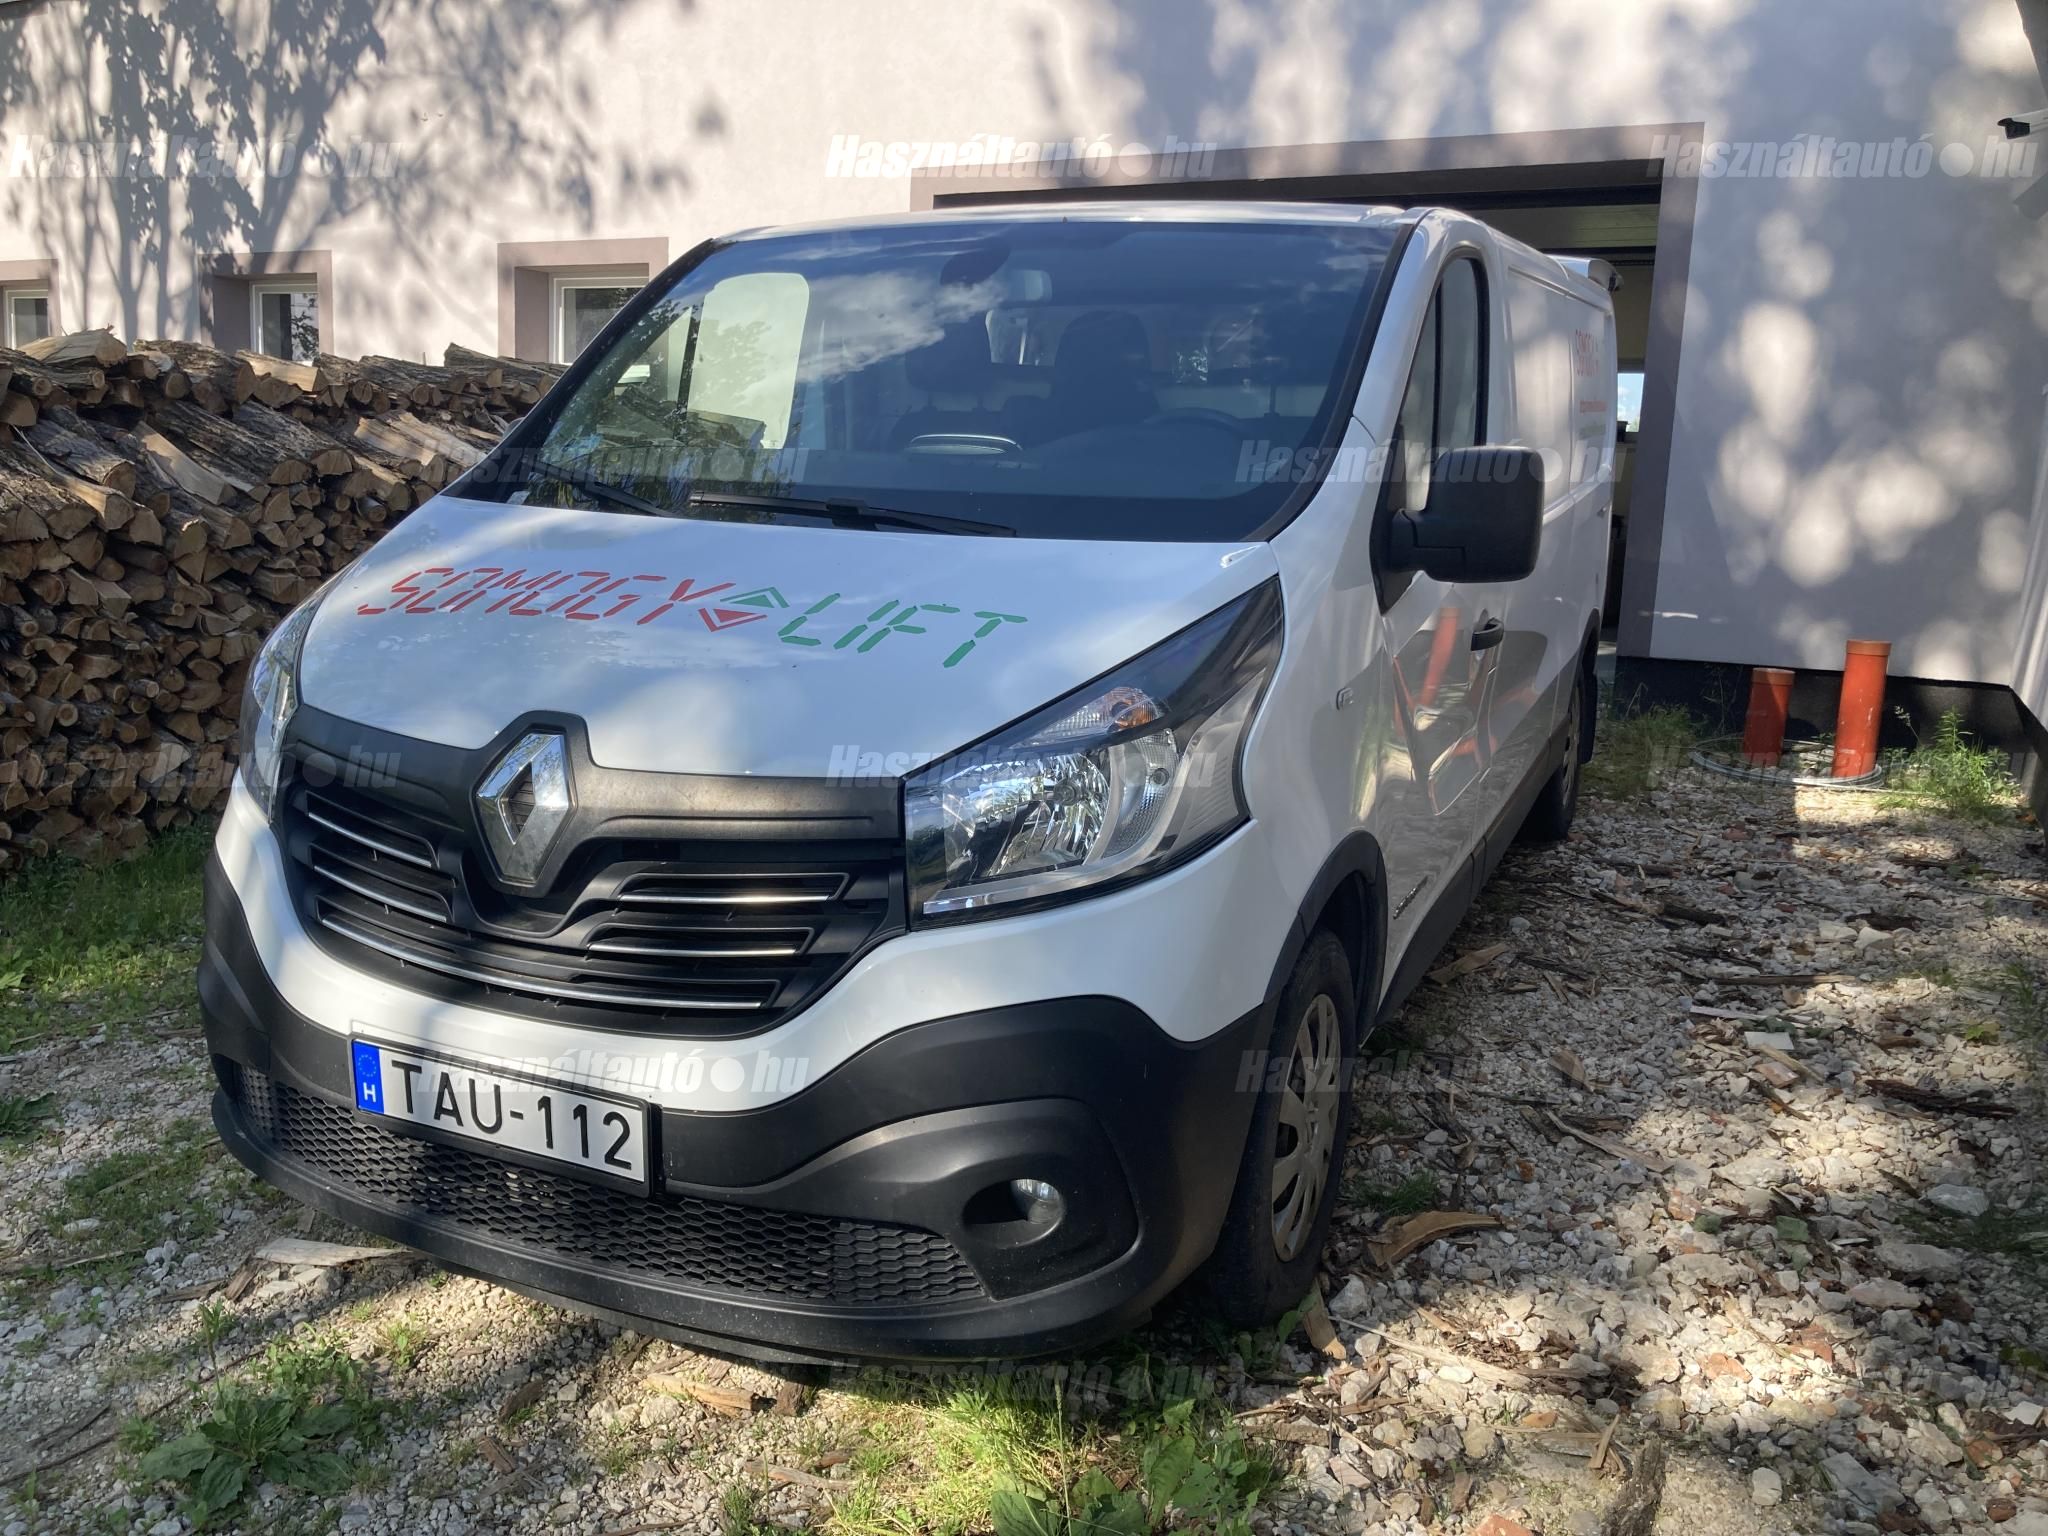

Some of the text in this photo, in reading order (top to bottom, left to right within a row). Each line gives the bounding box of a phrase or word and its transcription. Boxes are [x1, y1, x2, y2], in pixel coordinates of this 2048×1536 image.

[357, 567, 1028, 668] SOMOGY LIFT
[363, 1082, 377, 1102] H
[391, 1059, 632, 1170] TAU-112
